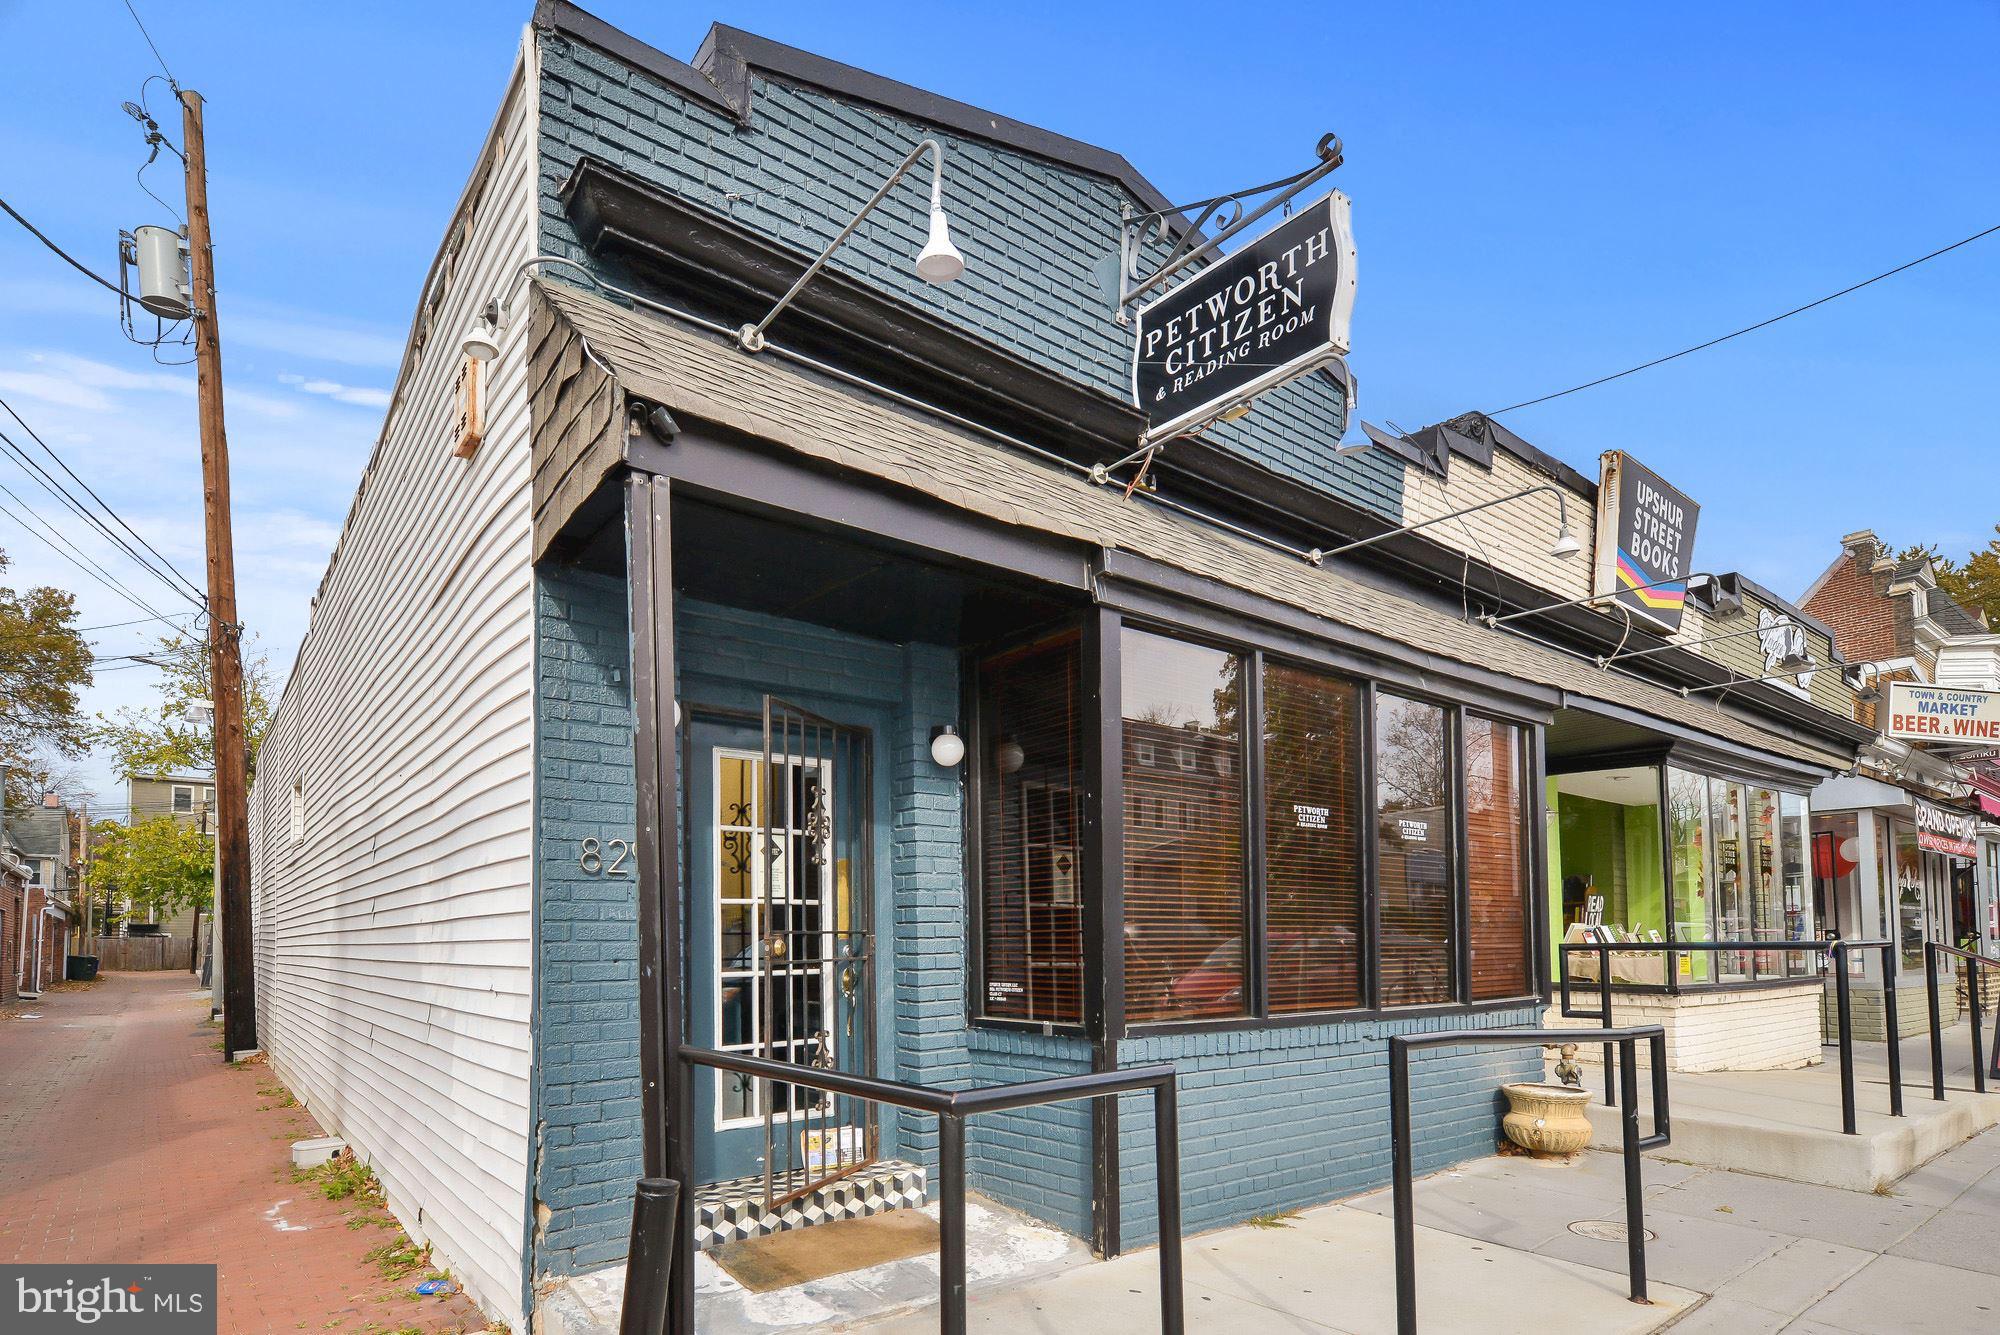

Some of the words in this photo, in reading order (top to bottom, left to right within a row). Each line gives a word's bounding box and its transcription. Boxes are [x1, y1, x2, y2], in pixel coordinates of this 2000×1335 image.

[1145, 227, 1329, 358] PETWORTH
[1165, 277, 1305, 375] CITIZEN
[1155, 386, 1167, 401] &
[1172, 341, 1250, 394] READING
[1257, 305, 1316, 349] ROOM
[1636, 480, 1684, 531] UPSHUR
[1633, 506, 1682, 553] STREET
[1630, 531, 1679, 579] BOOKS
[1909, 690, 1935, 700] TOWN
[1937, 692, 1944, 701] &
[1946, 693, 1989, 703] COUNTRY
[1917, 701, 1978, 716] MARKET
[1892, 714, 1940, 734] BEER
[1943, 725, 1950, 735] &
[1953, 718, 2000, 738] WINE
[1293, 804, 1330, 816] PETWORTH
[1298, 813, 1326, 824] CITIZEN
[1398, 819, 1428, 830] PETWORTH
[1915, 804, 1945, 832] GRAND
[1944, 812, 1977, 841] OPENING
[1402, 827, 1425, 836] CITIZEN
[581, 837, 637, 873] 82
[1586, 895, 1604, 912] READ
